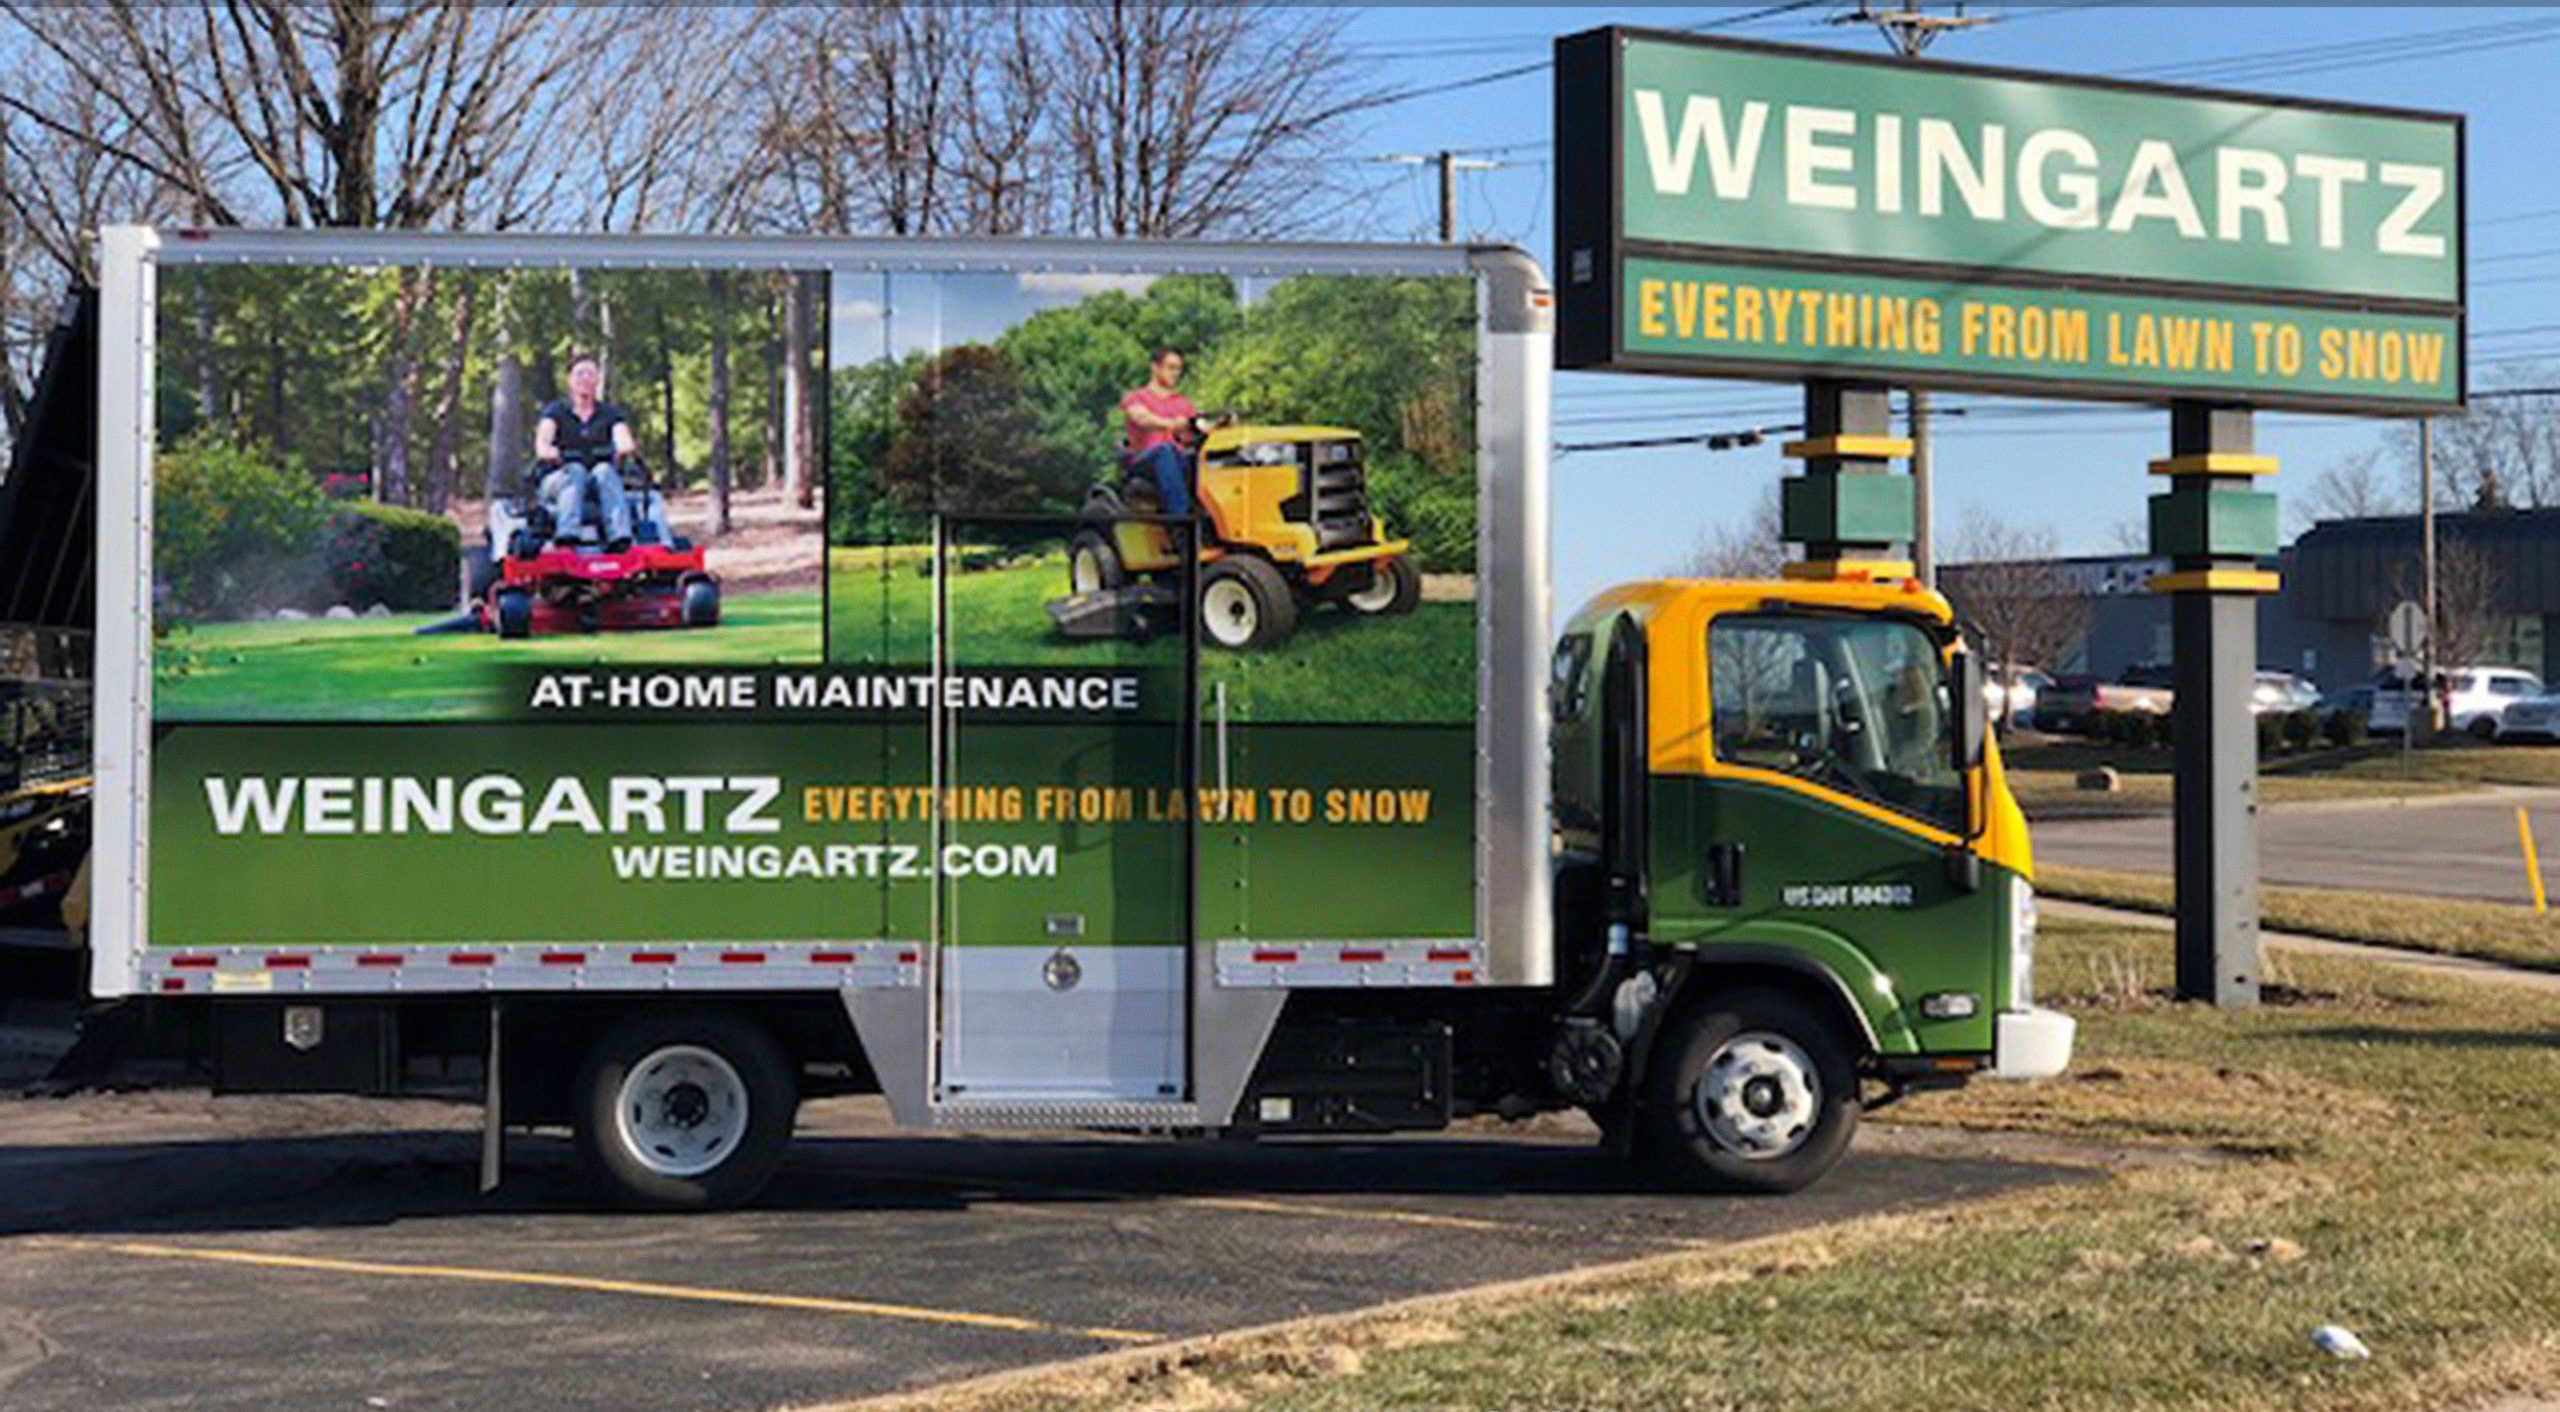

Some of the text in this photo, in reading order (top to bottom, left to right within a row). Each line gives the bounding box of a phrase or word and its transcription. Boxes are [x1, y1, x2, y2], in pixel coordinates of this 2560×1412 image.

[1634, 89, 2446, 258] WEINGARTZ
[1639, 279, 2443, 384] EVERYTHING FROM LAWN TO SNOW
[531, 675, 1138, 709] AT-HOME MAINTENANCE
[204, 775, 782, 834] WEINGARTZ
[804, 786, 1430, 823] EVERYTHING FROM LAWN TO SNOW
[612, 844, 1057, 878] WEINGARTZ.COM
